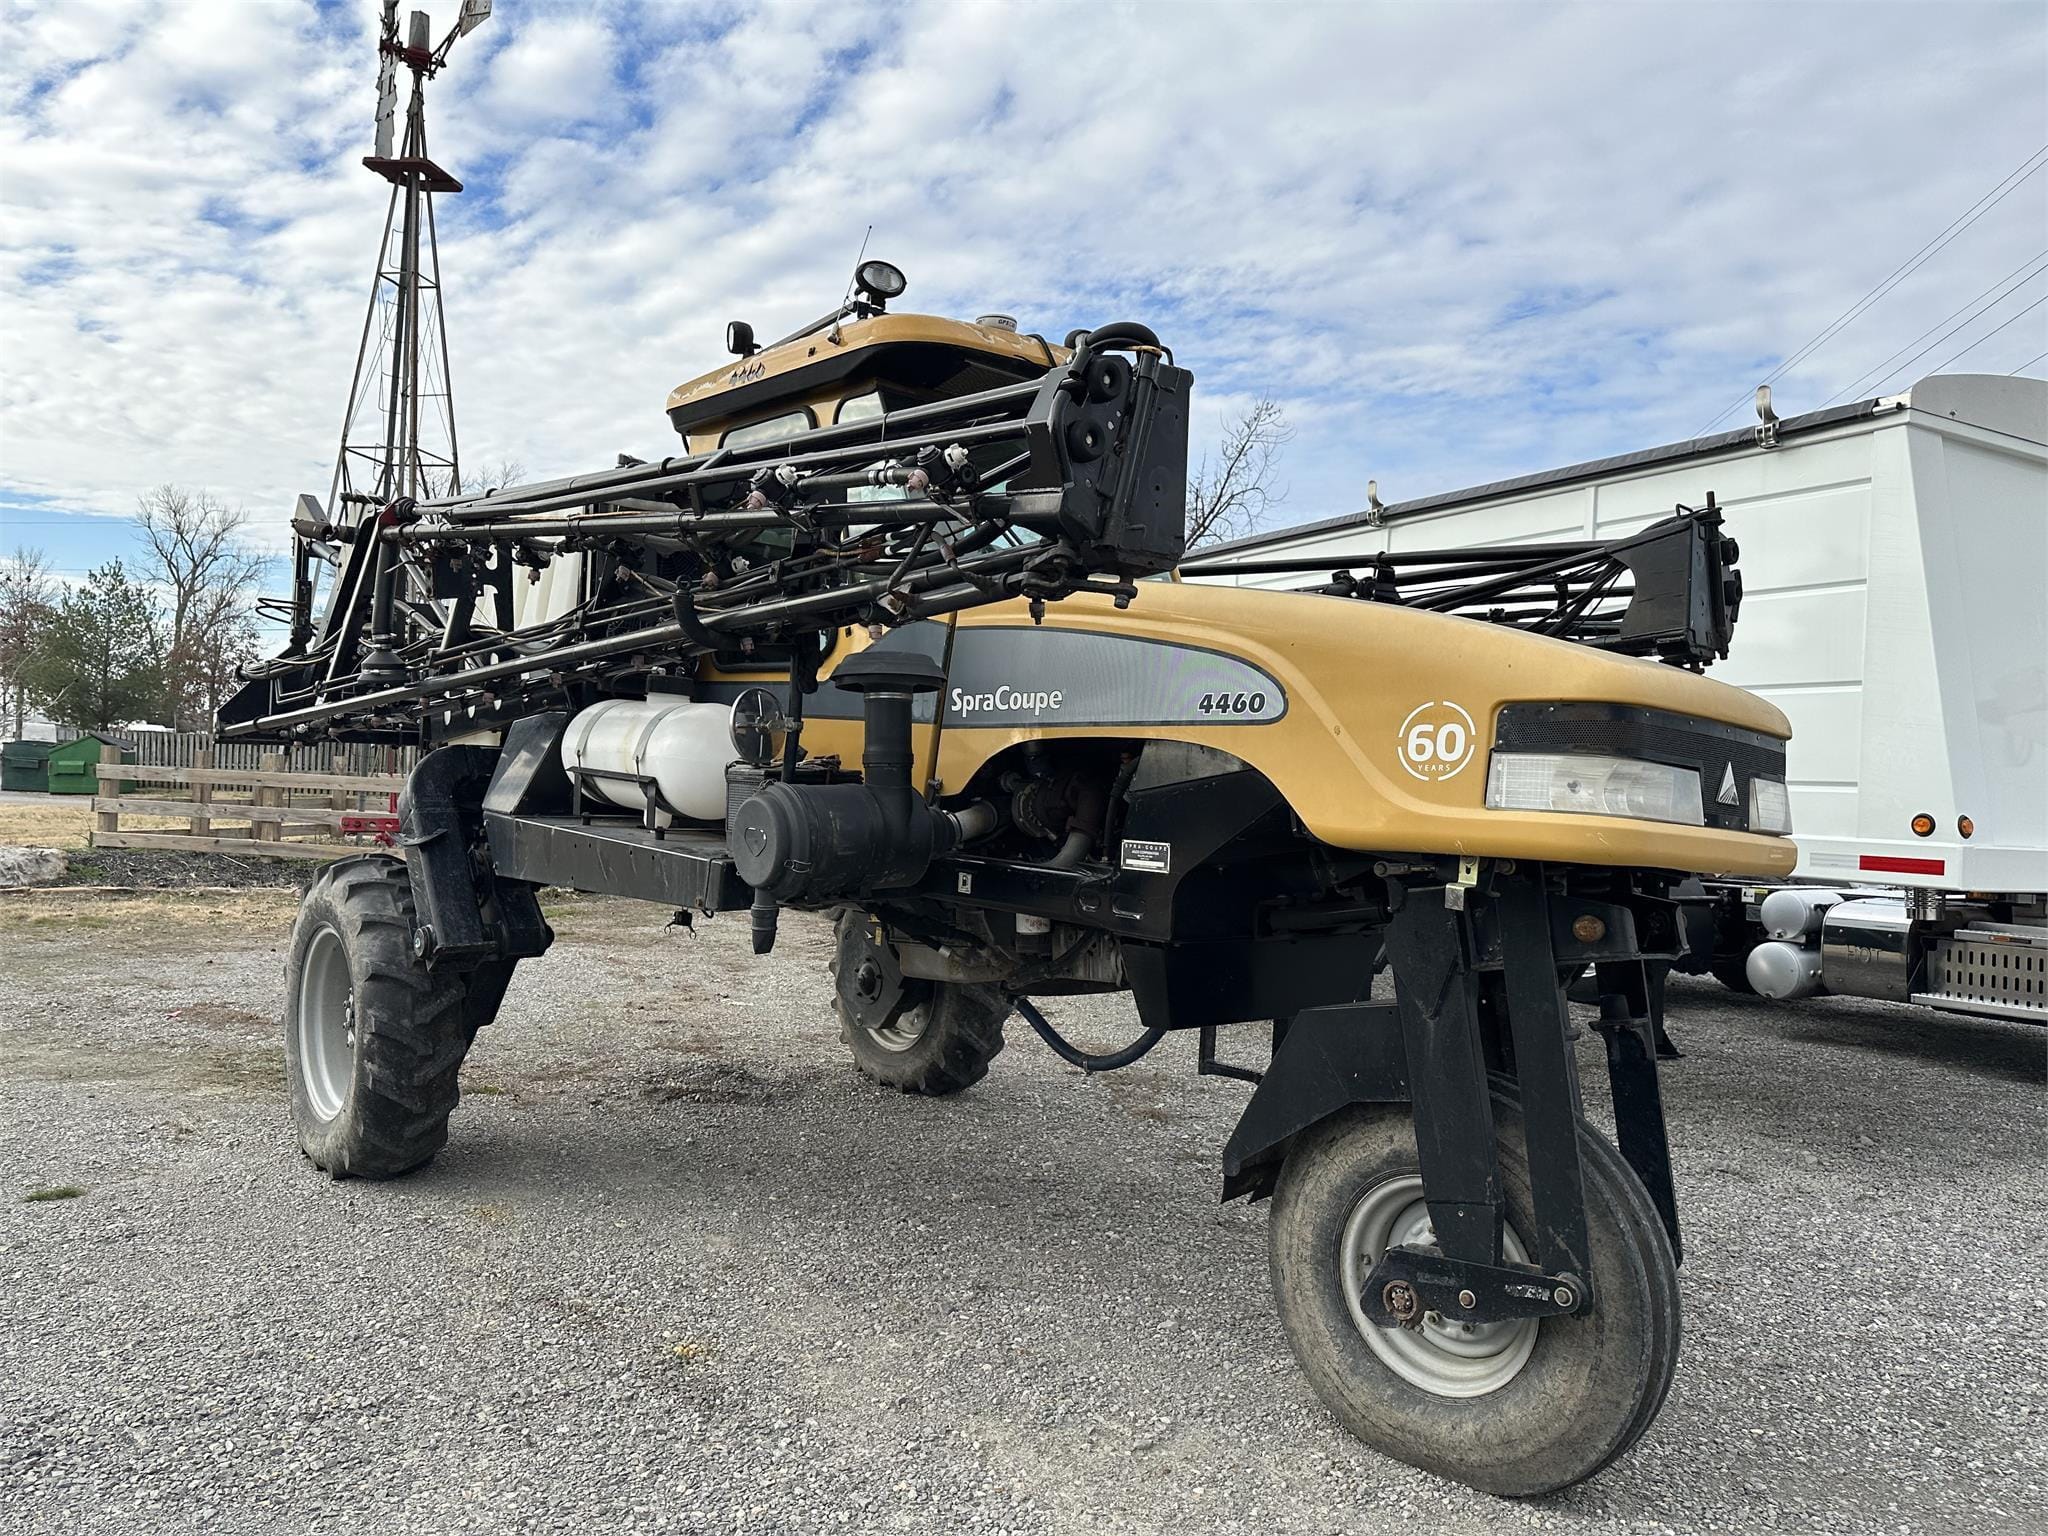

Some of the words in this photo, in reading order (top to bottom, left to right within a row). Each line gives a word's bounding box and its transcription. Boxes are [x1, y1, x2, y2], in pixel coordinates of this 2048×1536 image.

[951, 685, 1063, 718] SpraCoupe
[1198, 692, 1266, 716] 4460
[1407, 723, 1466, 762] 60
[1417, 764, 1451, 772] YEARS
